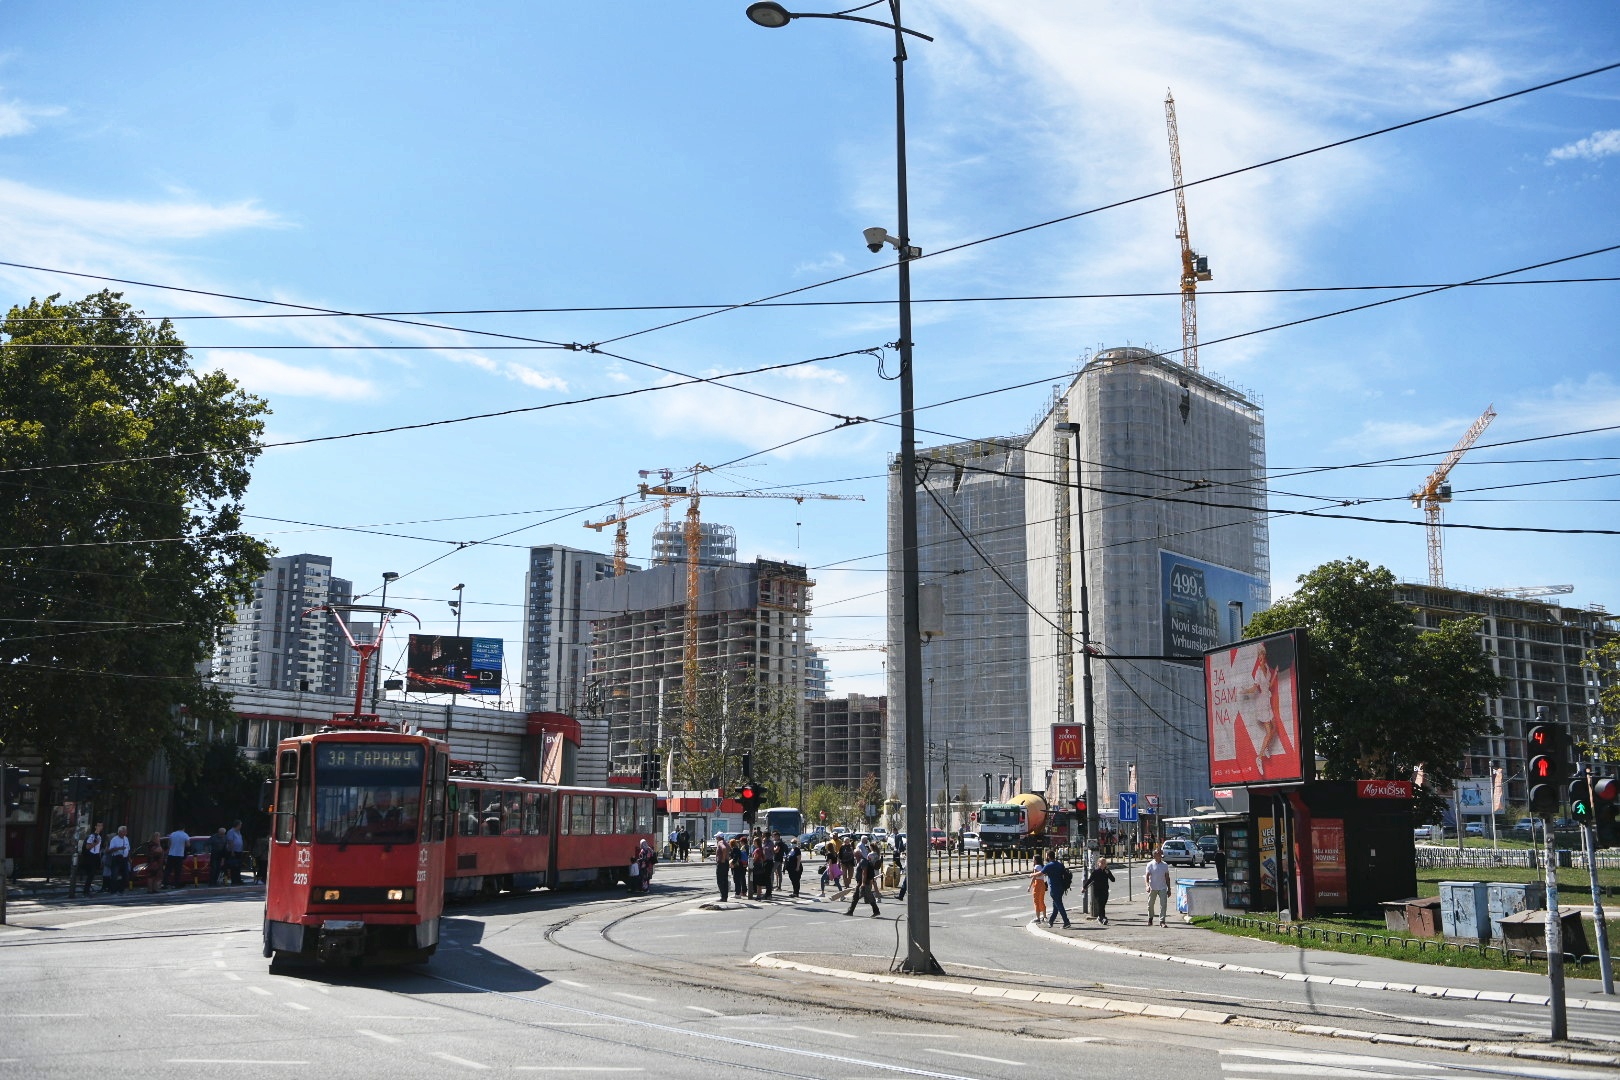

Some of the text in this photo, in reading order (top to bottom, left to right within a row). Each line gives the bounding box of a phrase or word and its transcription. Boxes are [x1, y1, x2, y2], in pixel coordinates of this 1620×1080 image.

[1171, 617, 1190, 633] Novi
[1171, 633, 1208, 651] Vrhunska
[1213, 669, 1226, 686] JA
[1214, 686, 1238, 706] SAM
[1215, 708, 1231, 726] NA
[546, 736, 560, 744] BW
[1534, 732, 1543, 744] 4
[328, 751, 345, 766] ЗА
[293, 873, 308, 885] 2275
